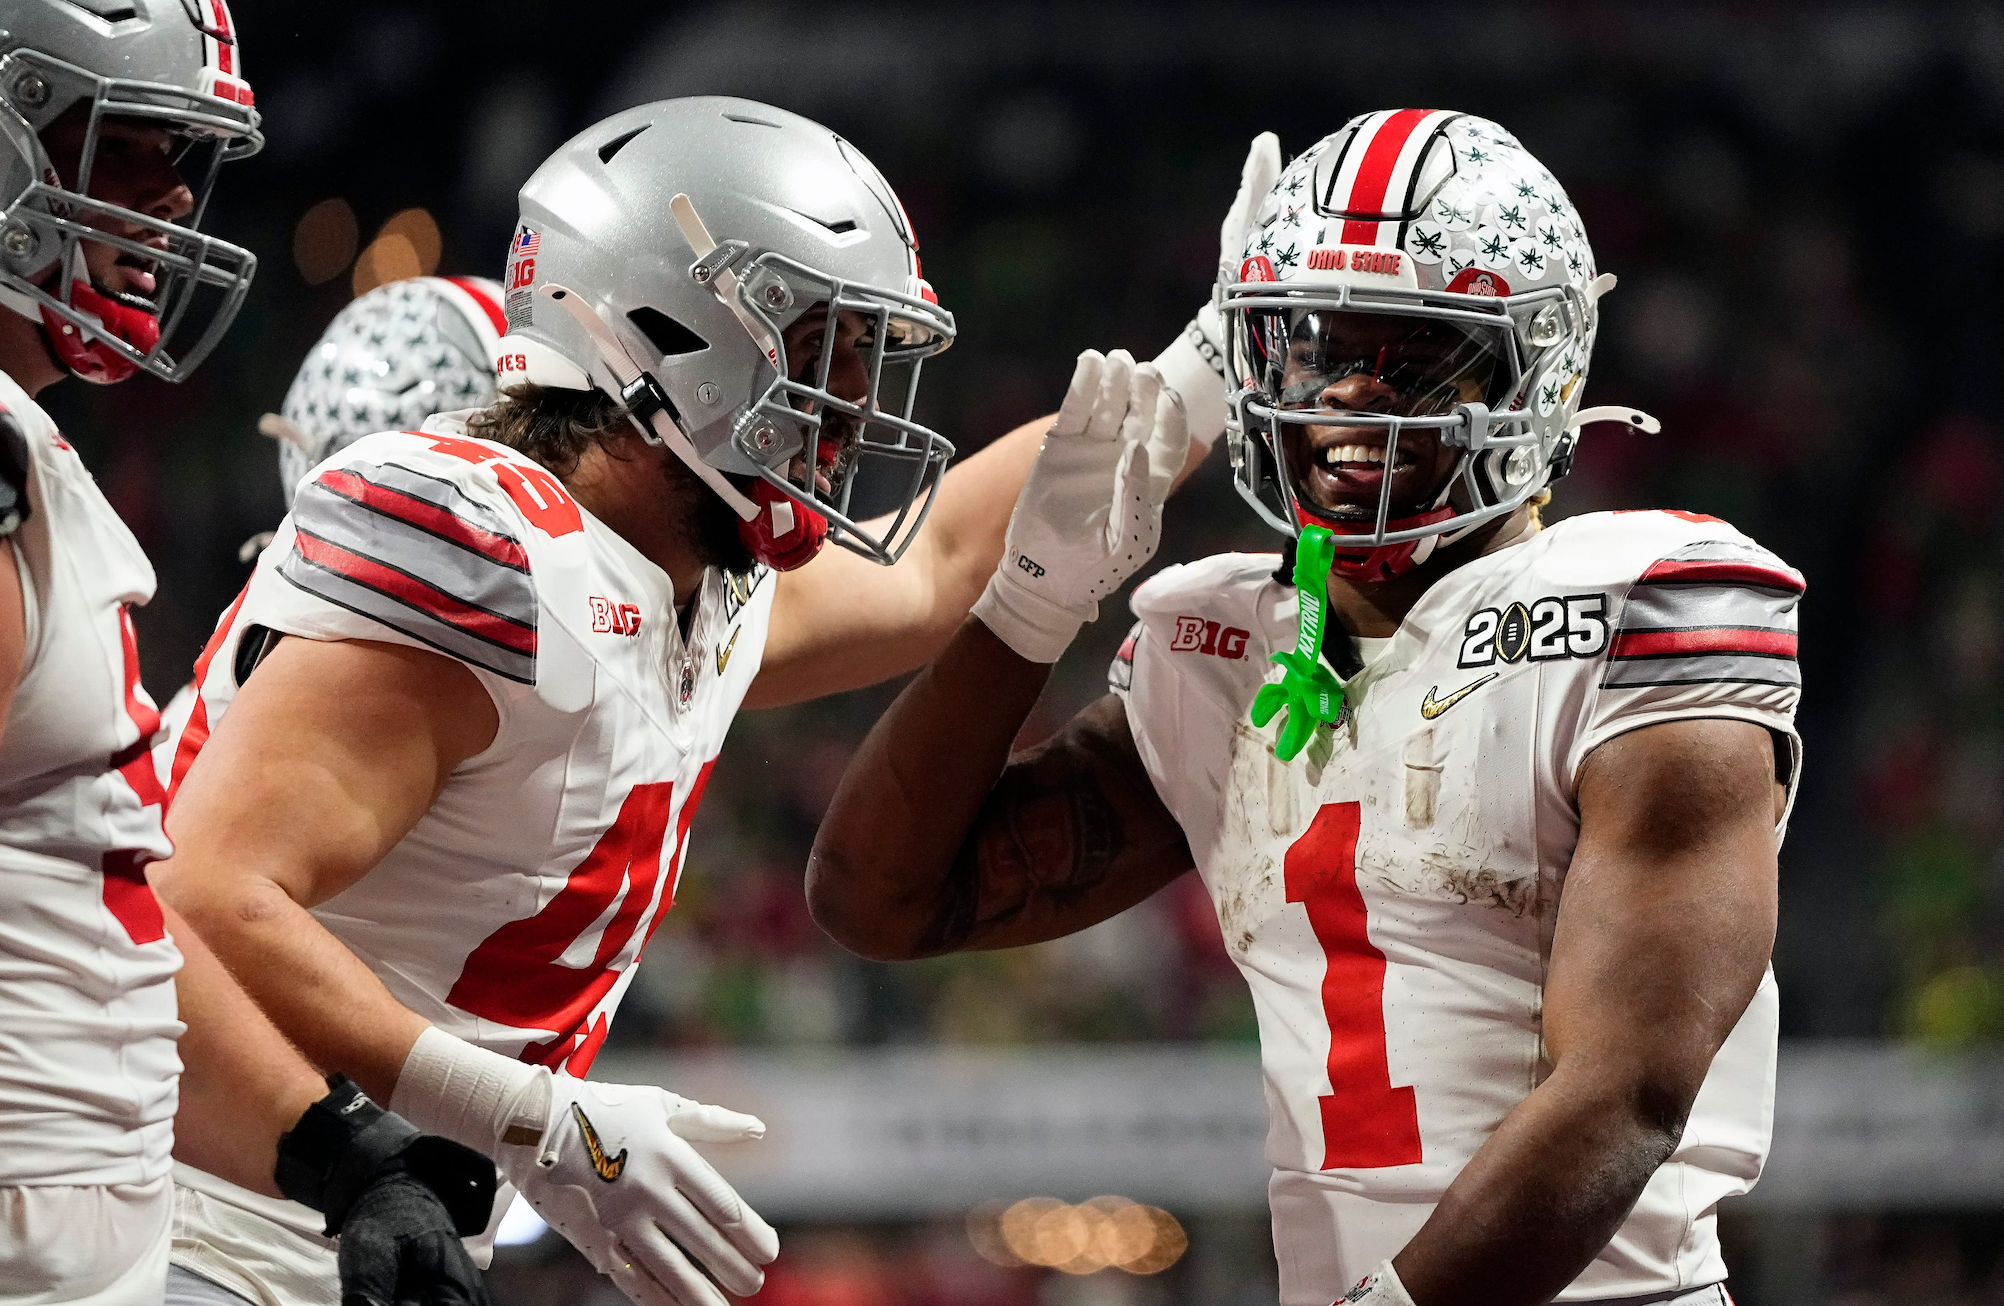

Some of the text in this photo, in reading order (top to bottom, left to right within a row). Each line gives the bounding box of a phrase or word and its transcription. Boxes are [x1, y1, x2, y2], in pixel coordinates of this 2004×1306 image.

[1307, 249, 1401, 275] OHIO STATE
[1018, 555, 1045, 578] CFP
[1298, 589, 1321, 661] NXTRND
[1457, 592, 1610, 669] 2025
[1284, 800, 1423, 1170] 1
